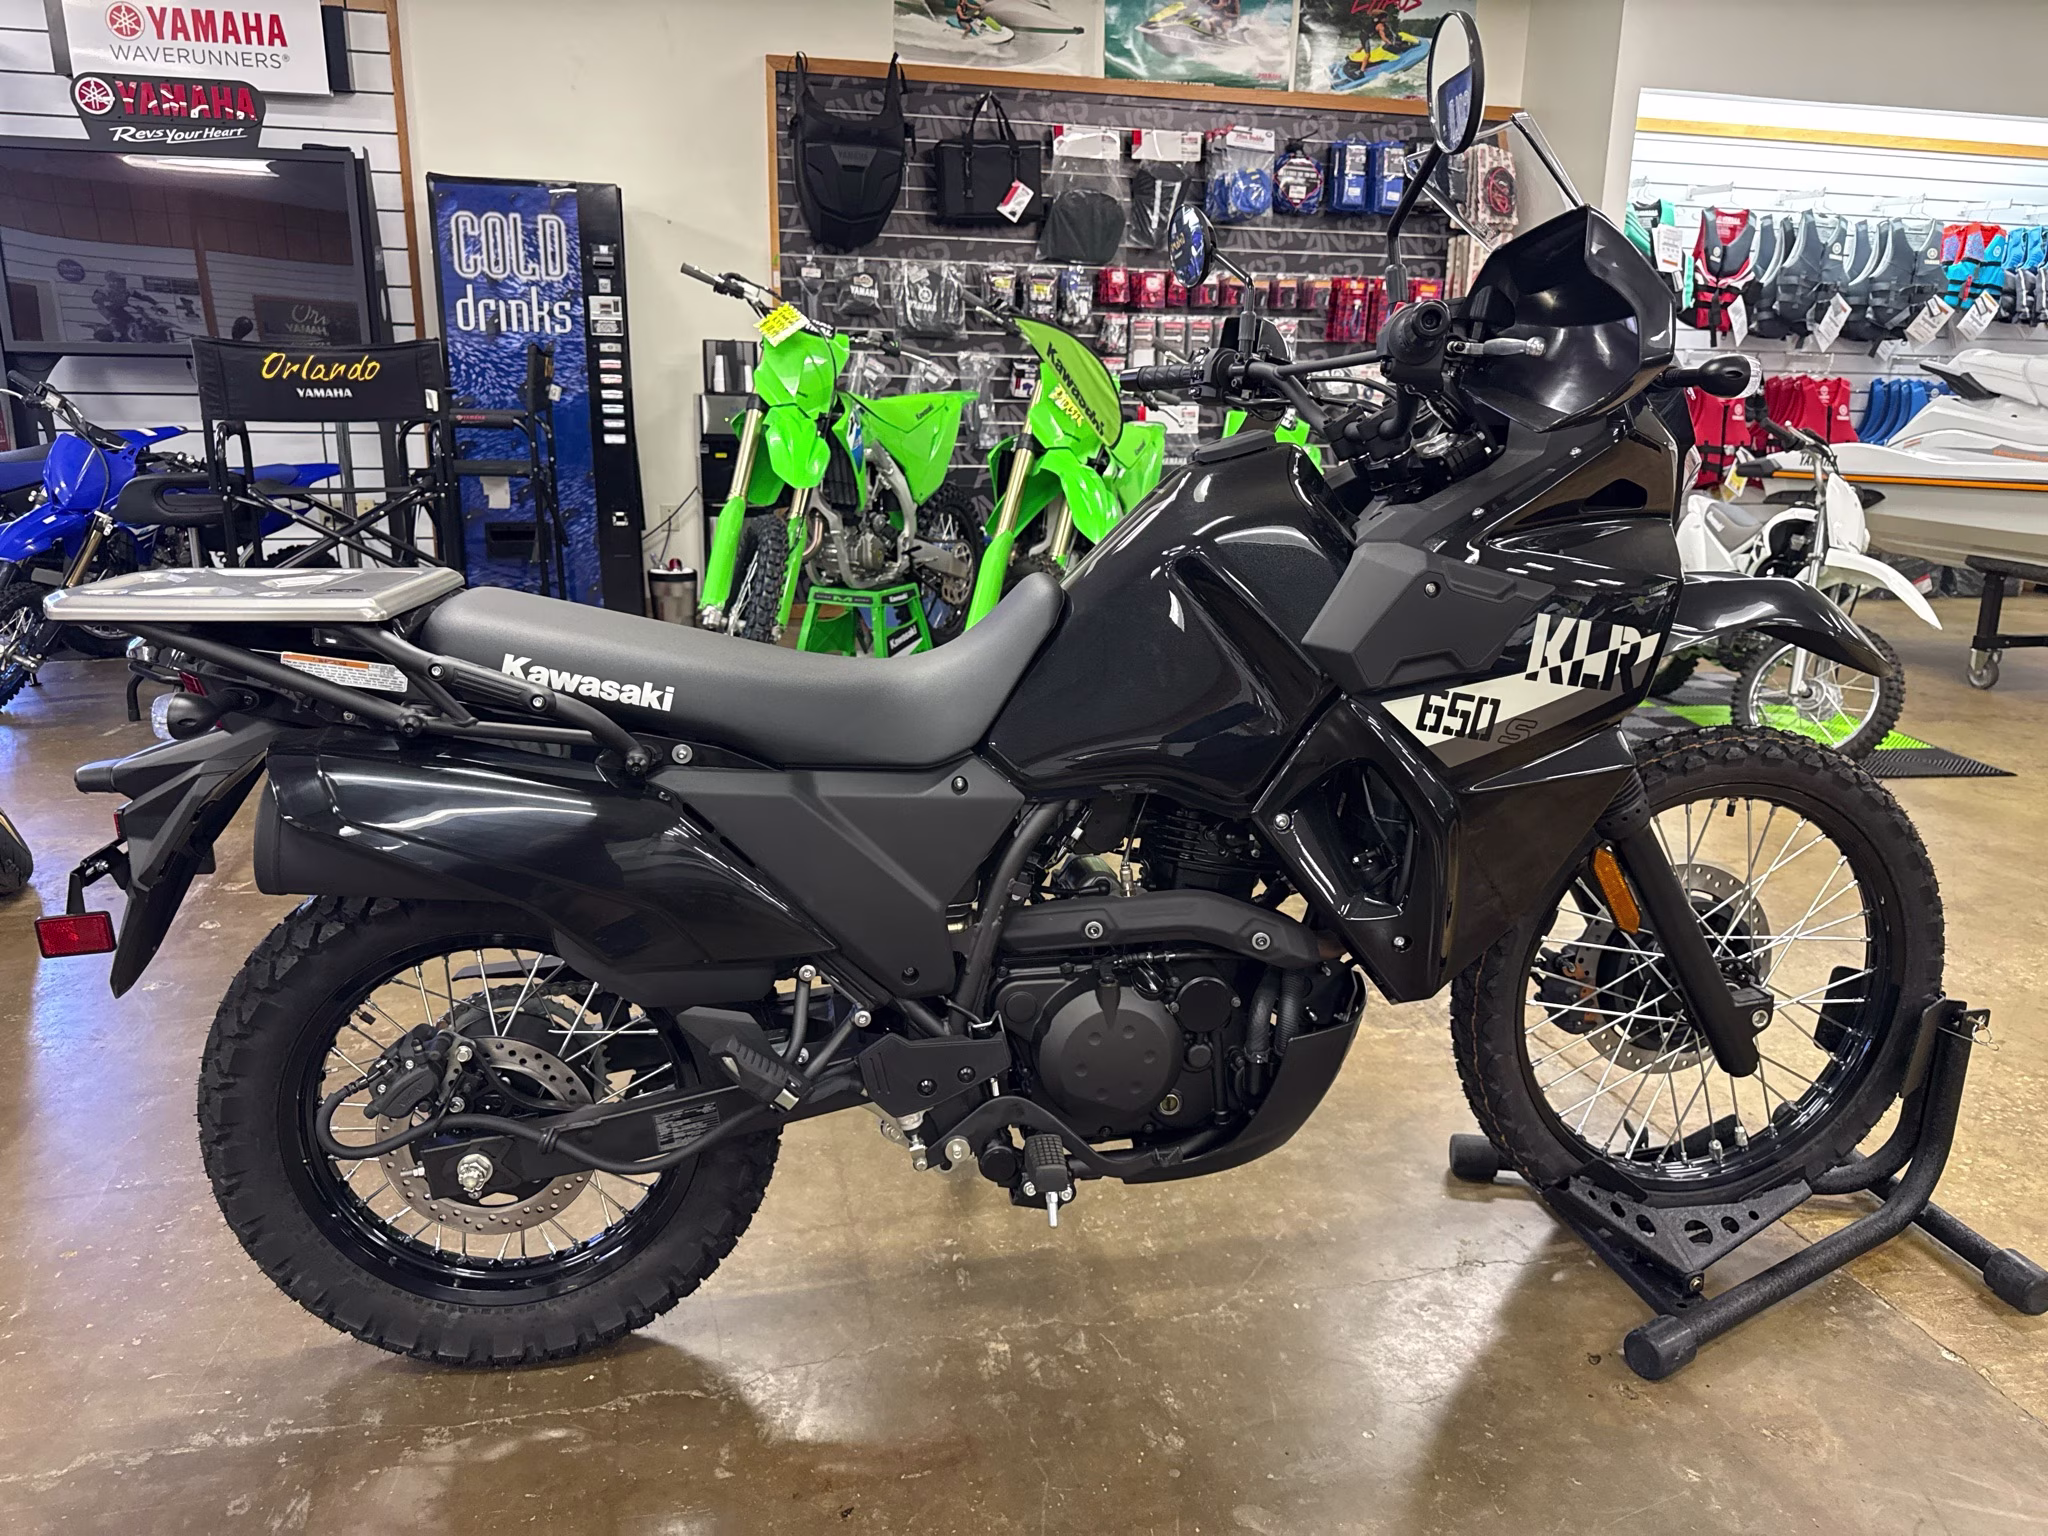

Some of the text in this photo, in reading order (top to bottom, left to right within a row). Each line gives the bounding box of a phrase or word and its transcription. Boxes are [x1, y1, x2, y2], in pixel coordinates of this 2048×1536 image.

[145, 6, 288, 47] YAMAHA
[115, 80, 258, 121] YAMAHA
[109, 126, 247, 144] Revs Your Heart
[451, 210, 568, 281] COLD
[456, 284, 573, 334] drinks
[851, 285, 879, 299] YAMAHA
[261, 352, 381, 381] Orlando
[296, 388, 353, 398] YAMAHA
[1525, 613, 1642, 692] KLR
[501, 654, 675, 712] Kawasaki
[1416, 690, 1537, 744] 650 S
